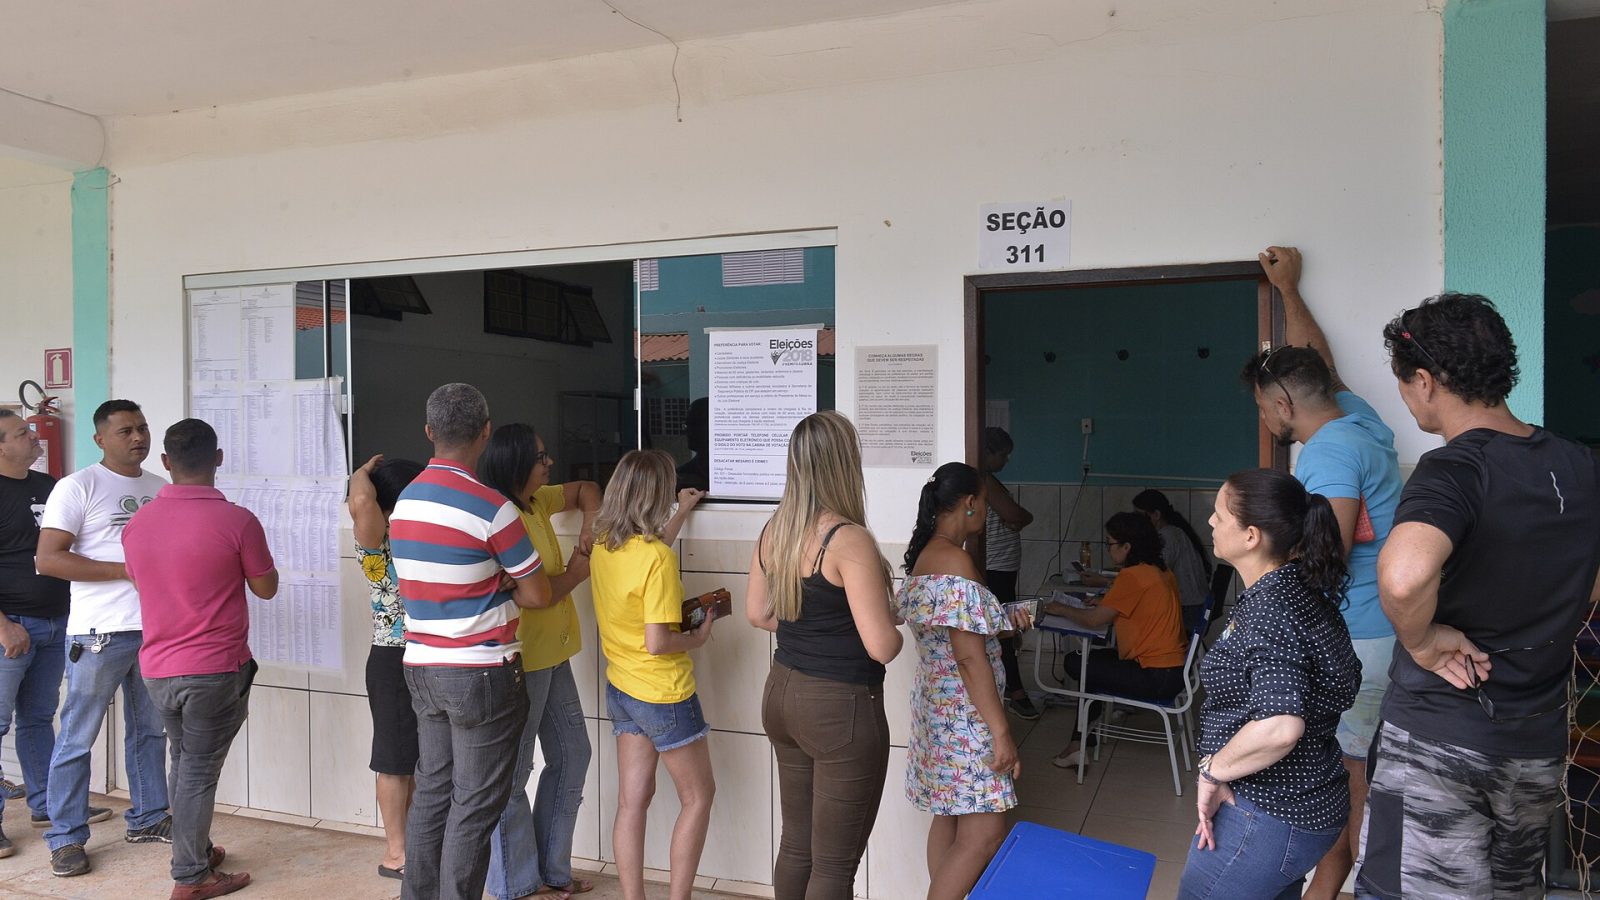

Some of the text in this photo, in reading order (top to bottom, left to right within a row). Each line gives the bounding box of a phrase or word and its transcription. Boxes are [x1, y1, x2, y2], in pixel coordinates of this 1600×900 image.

[986, 206, 1066, 235] SEÇÃO
[1005, 244, 1045, 264] 311
[770, 339, 813, 350] Eleições
[782, 349, 813, 362] 2018
